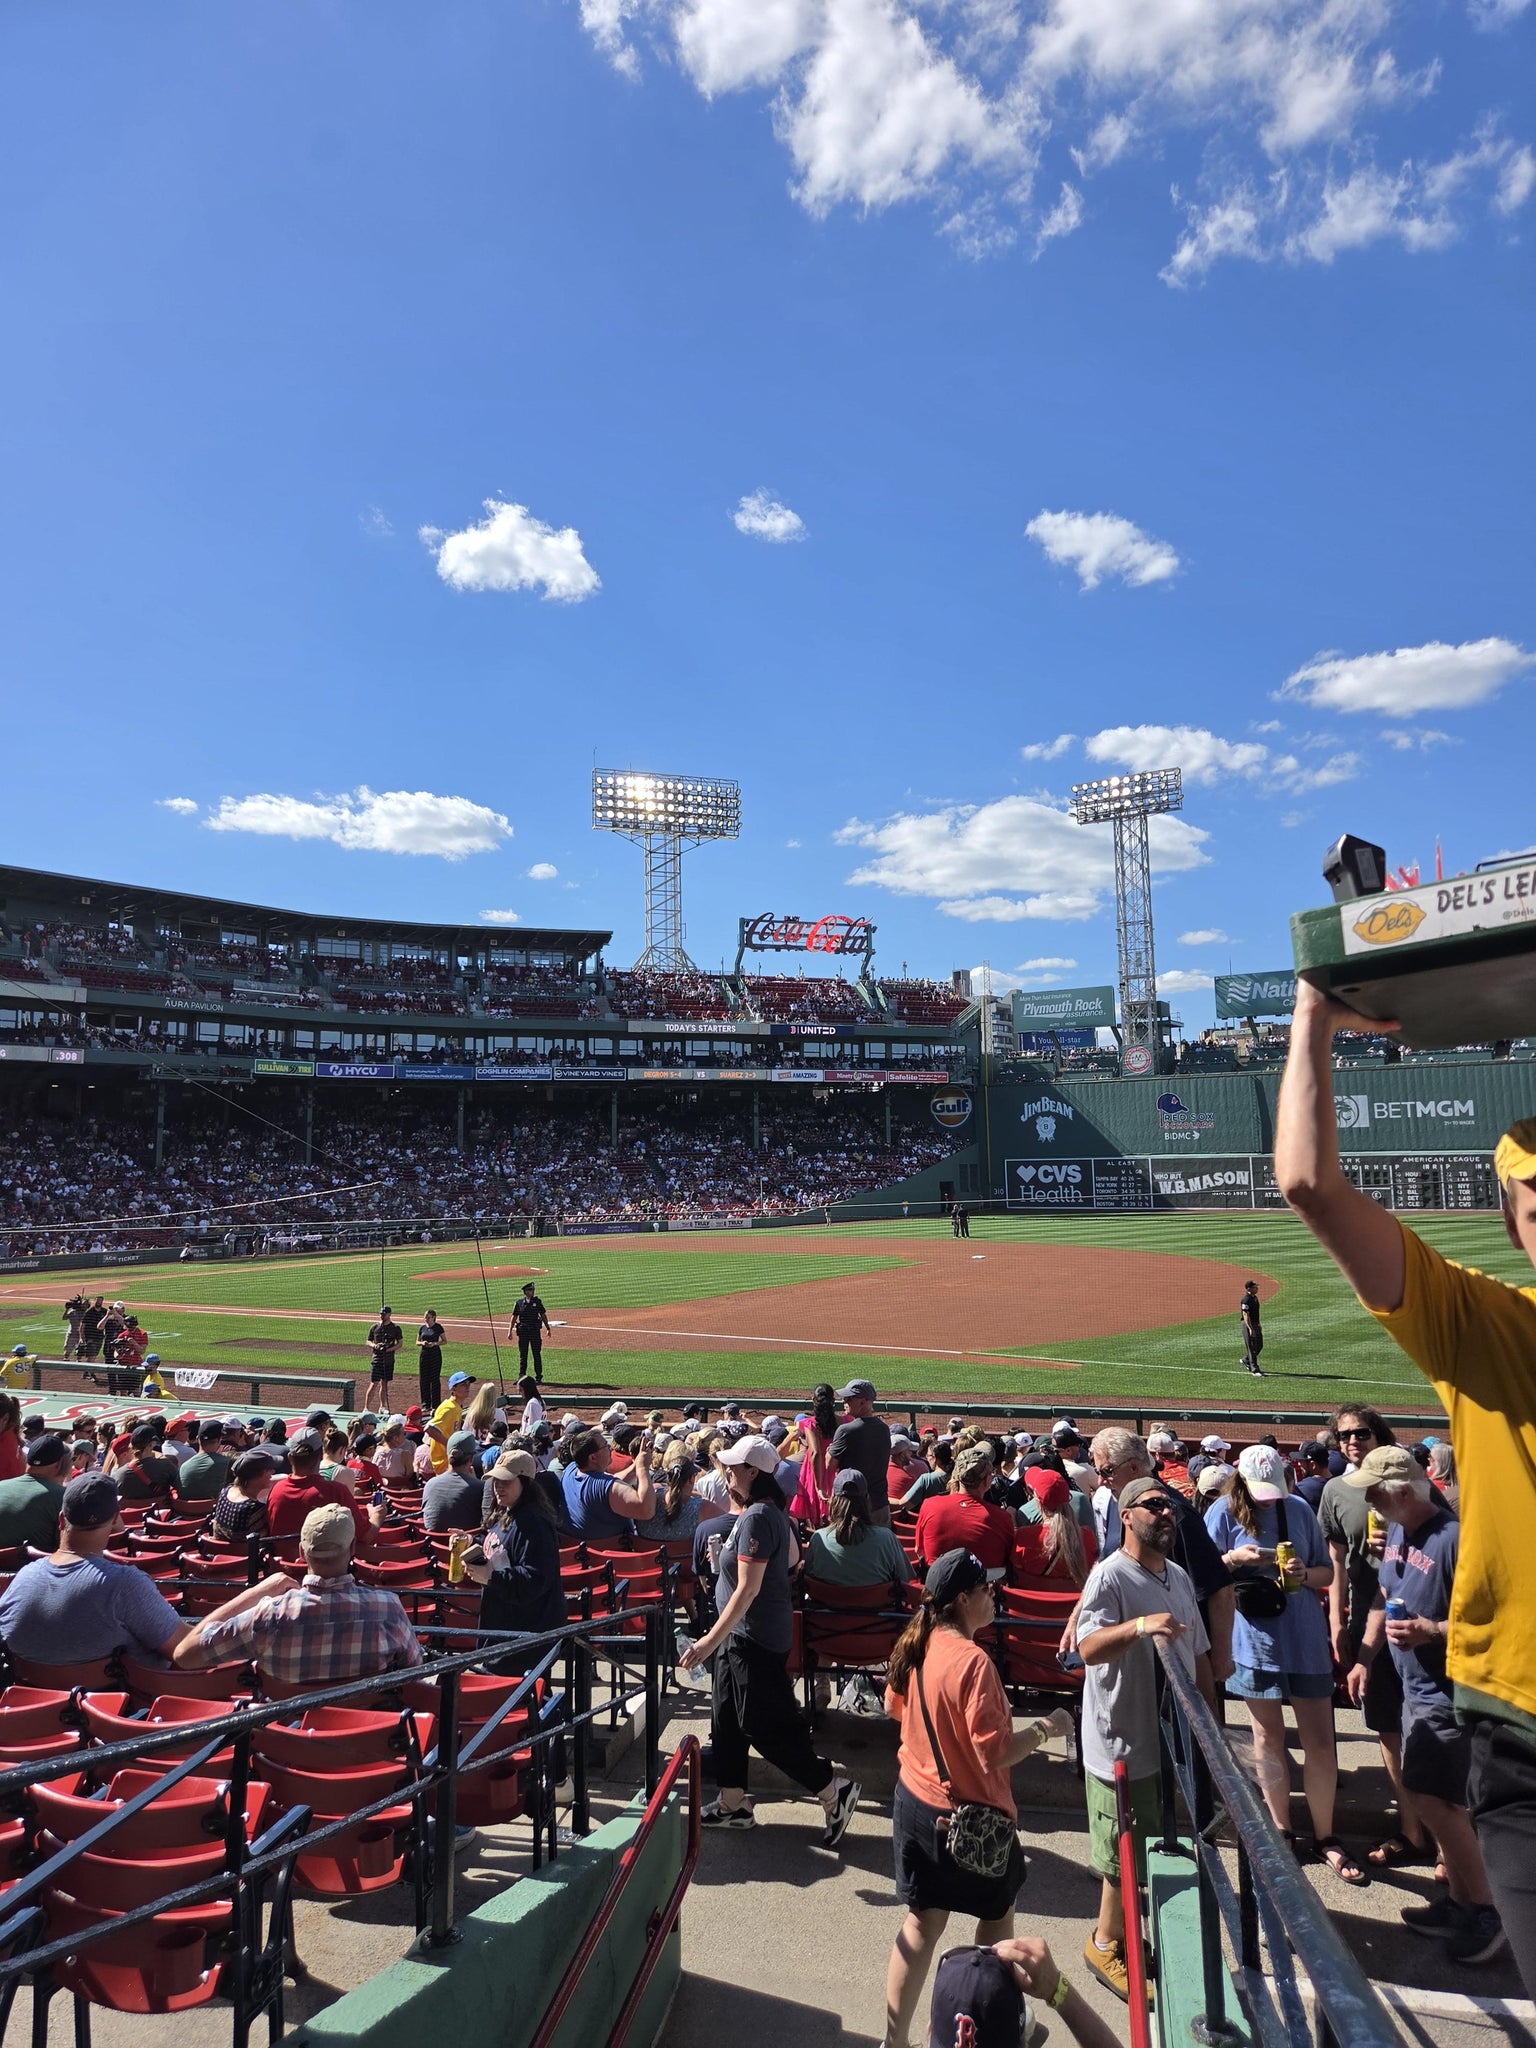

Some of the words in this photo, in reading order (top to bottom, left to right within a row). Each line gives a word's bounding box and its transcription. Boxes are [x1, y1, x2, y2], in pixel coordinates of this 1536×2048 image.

[1437, 879, 1496, 913] DEL'S
[1368, 910, 1413, 935] Del's
[745, 911, 870, 953] Coca-Cola
[190, 1001, 224, 1012] PAVILION
[1023, 1000, 1072, 1016] Plymouth
[1074, 997, 1103, 1011] Rock
[664, 1024, 697, 1032] TODAY'S
[698, 1024, 736, 1033] STARTERS
[800, 1025, 836, 1035] UNITED
[56, 1052, 77, 1061] .308
[257, 1062, 289, 1072] SULLIVAN
[345, 1066, 378, 1075] HYCU
[889, 1073, 918, 1081] Safelite
[932, 1100, 970, 1114] Gulf
[1374, 1100, 1475, 1118] BETMGM
[1164, 1114, 1188, 1122] RED
[1190, 1113, 1214, 1121] SOX
[1164, 1121, 1214, 1130] SCHOLARS
[1165, 1132, 1191, 1140] BIDMC
[1037, 1164, 1082, 1183] CVS
[1153, 1172, 1169, 1180] WHO
[1158, 1170, 1249, 1195] W.B.MASON
[1019, 1185, 1084, 1203] Health
[566, 1226, 588, 1235] xfinity
[118, 1255, 139, 1263] TICKET
[14, 1362, 32, 1374] 85
